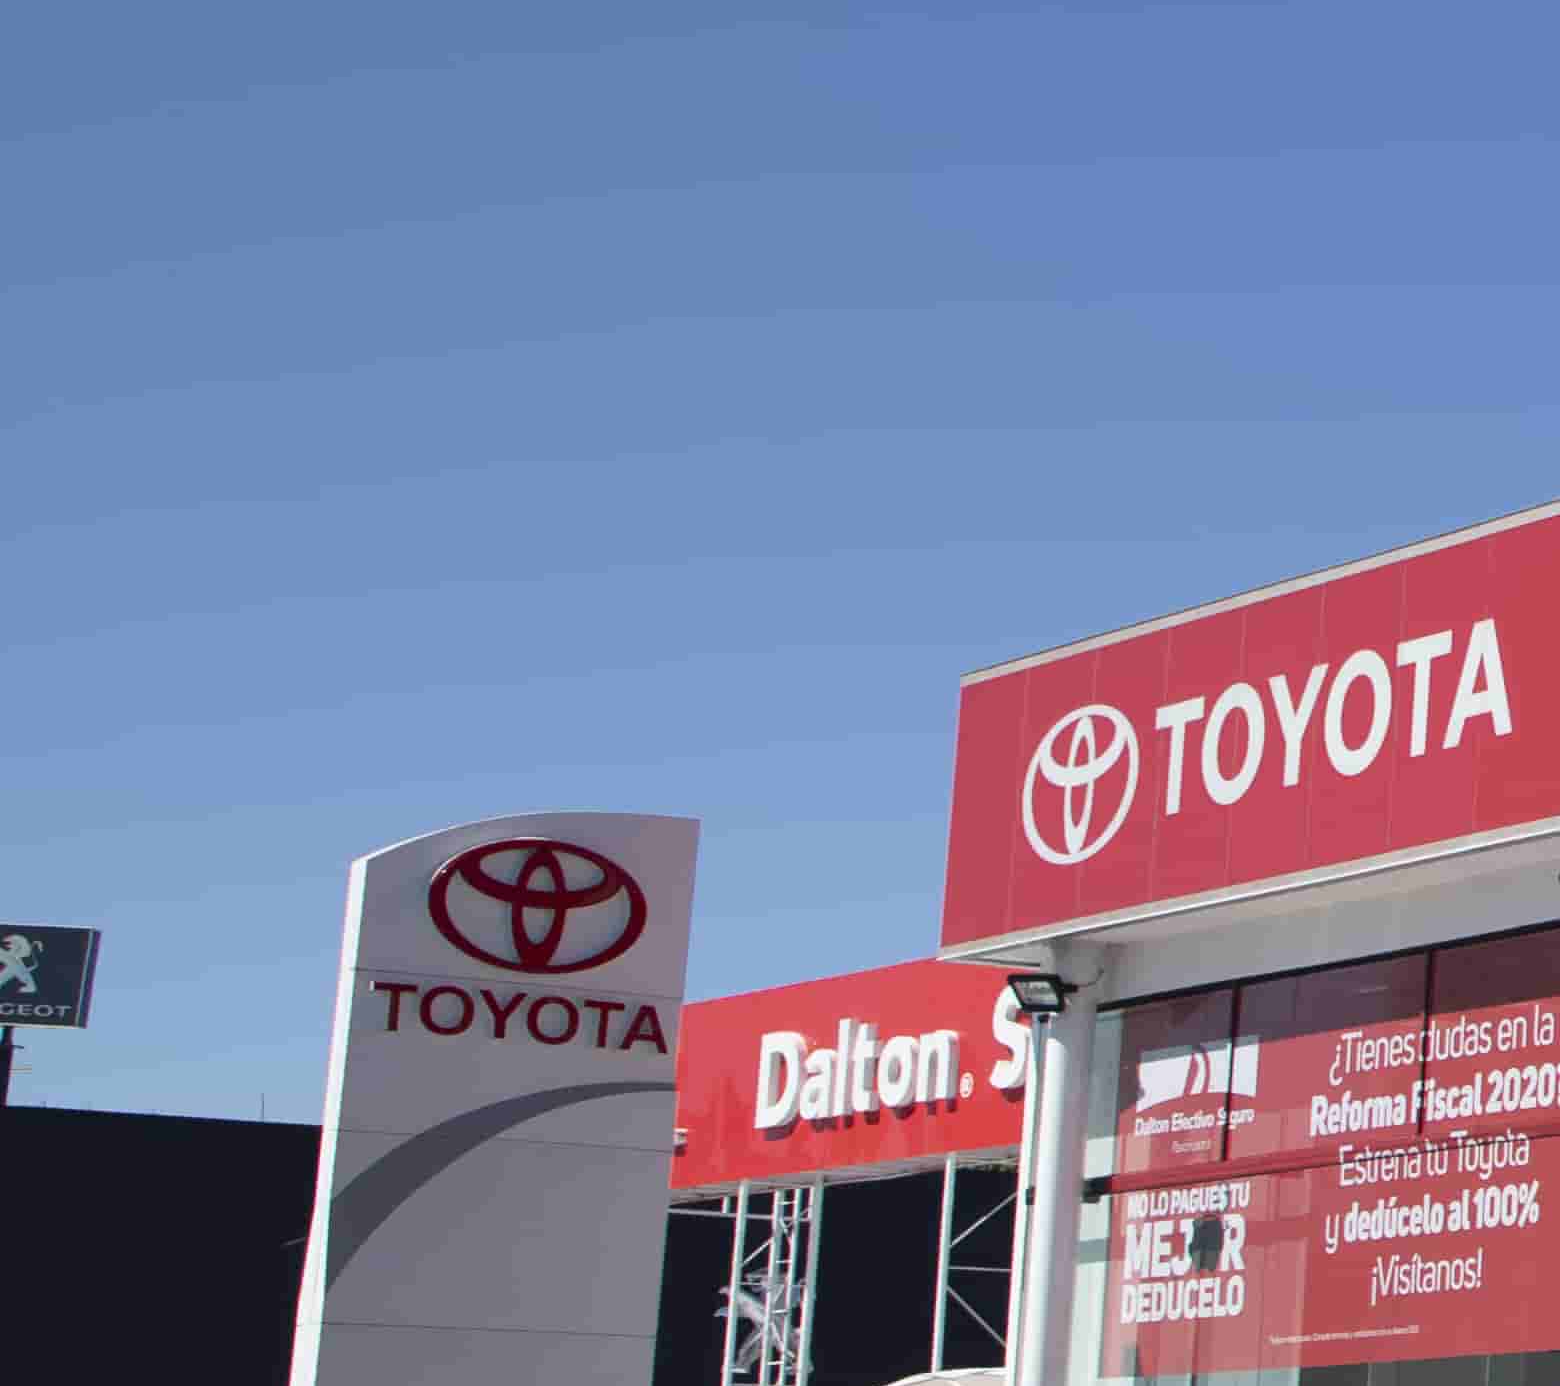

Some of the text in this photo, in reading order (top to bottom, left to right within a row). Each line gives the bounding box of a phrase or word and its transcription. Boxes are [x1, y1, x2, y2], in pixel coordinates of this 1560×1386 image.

[1155, 617, 1513, 817] TOYOTA
[368, 980, 668, 1055] TOYOTA
[1329, 1004, 1555, 1086] ¿Tienes dudas en la
[754, 1017, 960, 1130] Dalton
[1310, 1090, 1406, 1137] Reforma
[1411, 1072, 1483, 1125] Fiscal
[1339, 1128, 1530, 1188] Estrena tu Toyota
[1325, 1178, 1541, 1254] y dedúcelo al 100%
[1371, 1245, 1484, 1307] ¡Visítanos!
